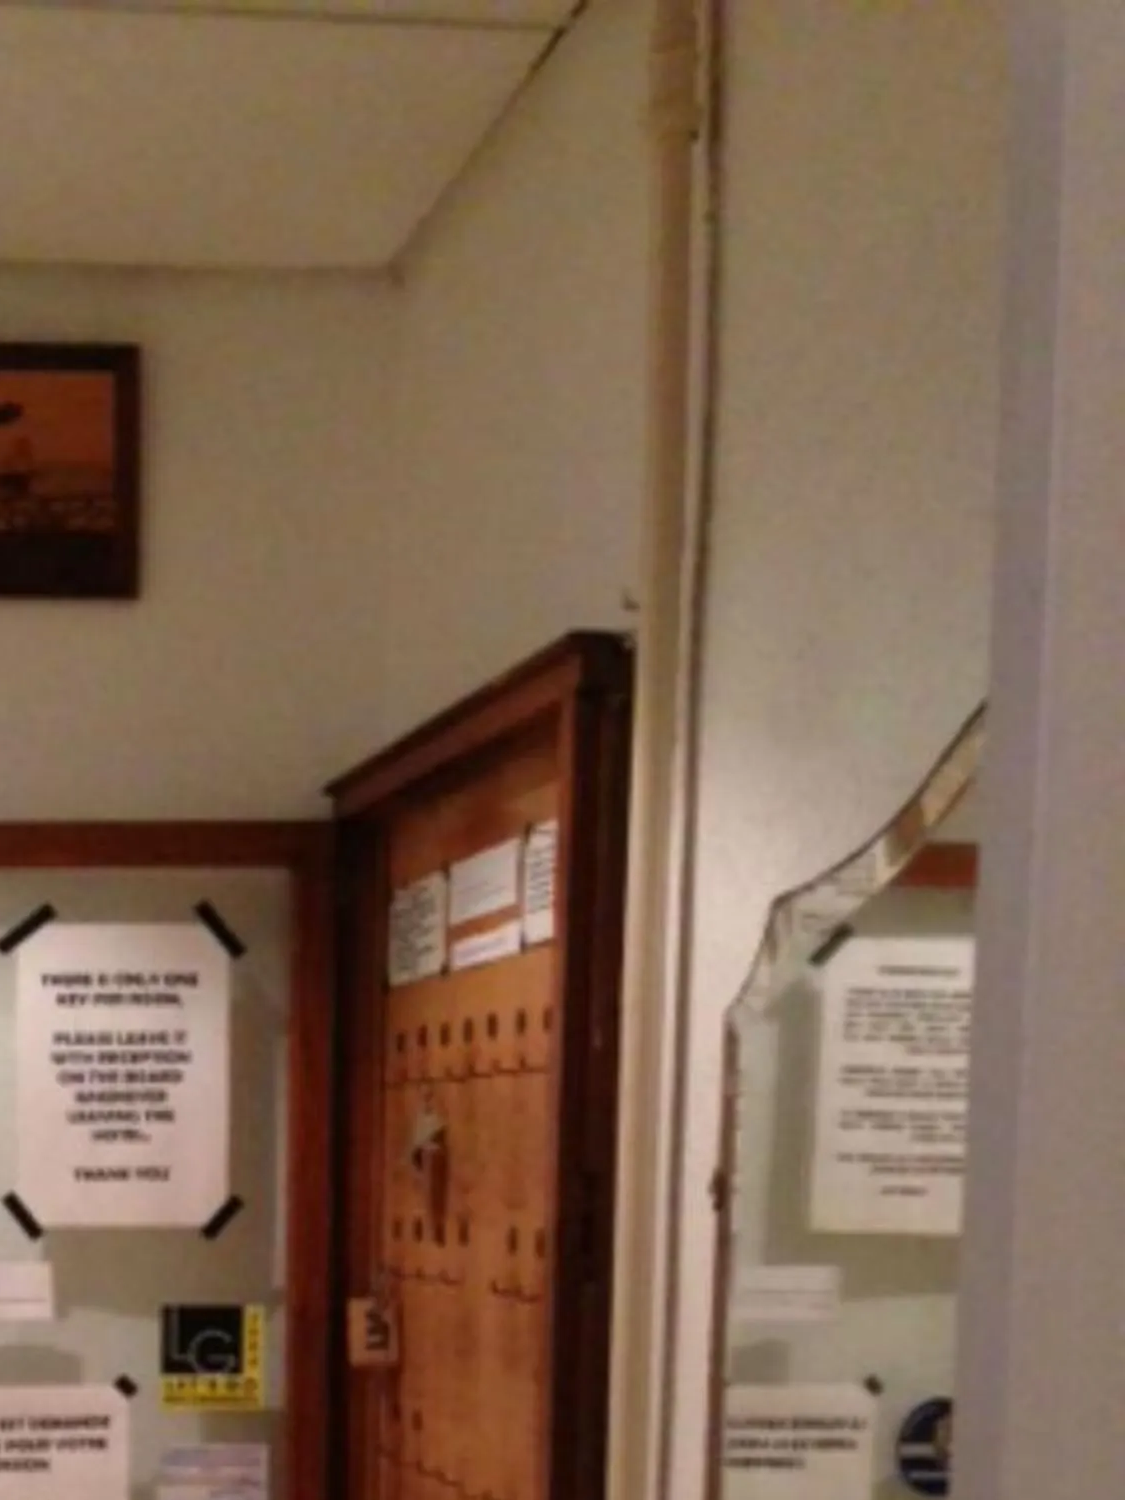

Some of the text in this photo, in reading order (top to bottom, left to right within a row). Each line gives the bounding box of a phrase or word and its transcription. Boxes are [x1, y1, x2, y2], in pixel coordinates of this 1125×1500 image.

[41, 972, 92, 986] THERE
[112, 972, 160, 986] ONLY
[164, 971, 199, 987] ONE
[56, 992, 88, 1006] KEY
[52, 1030, 187, 1046] PLEASE LEAVE IT
[50, 1050, 192, 1065] WITH RECEPTION
[57, 1070, 184, 1084] ON THE BOARD
[65, 1109, 175, 1124] LEAVING THE
[73, 1166, 170, 1182] THANK YOU
[0, 1417, 24, 1432] EST
[5, 1438, 50, 1452] POUR
[56, 1437, 108, 1450] VOTRE
